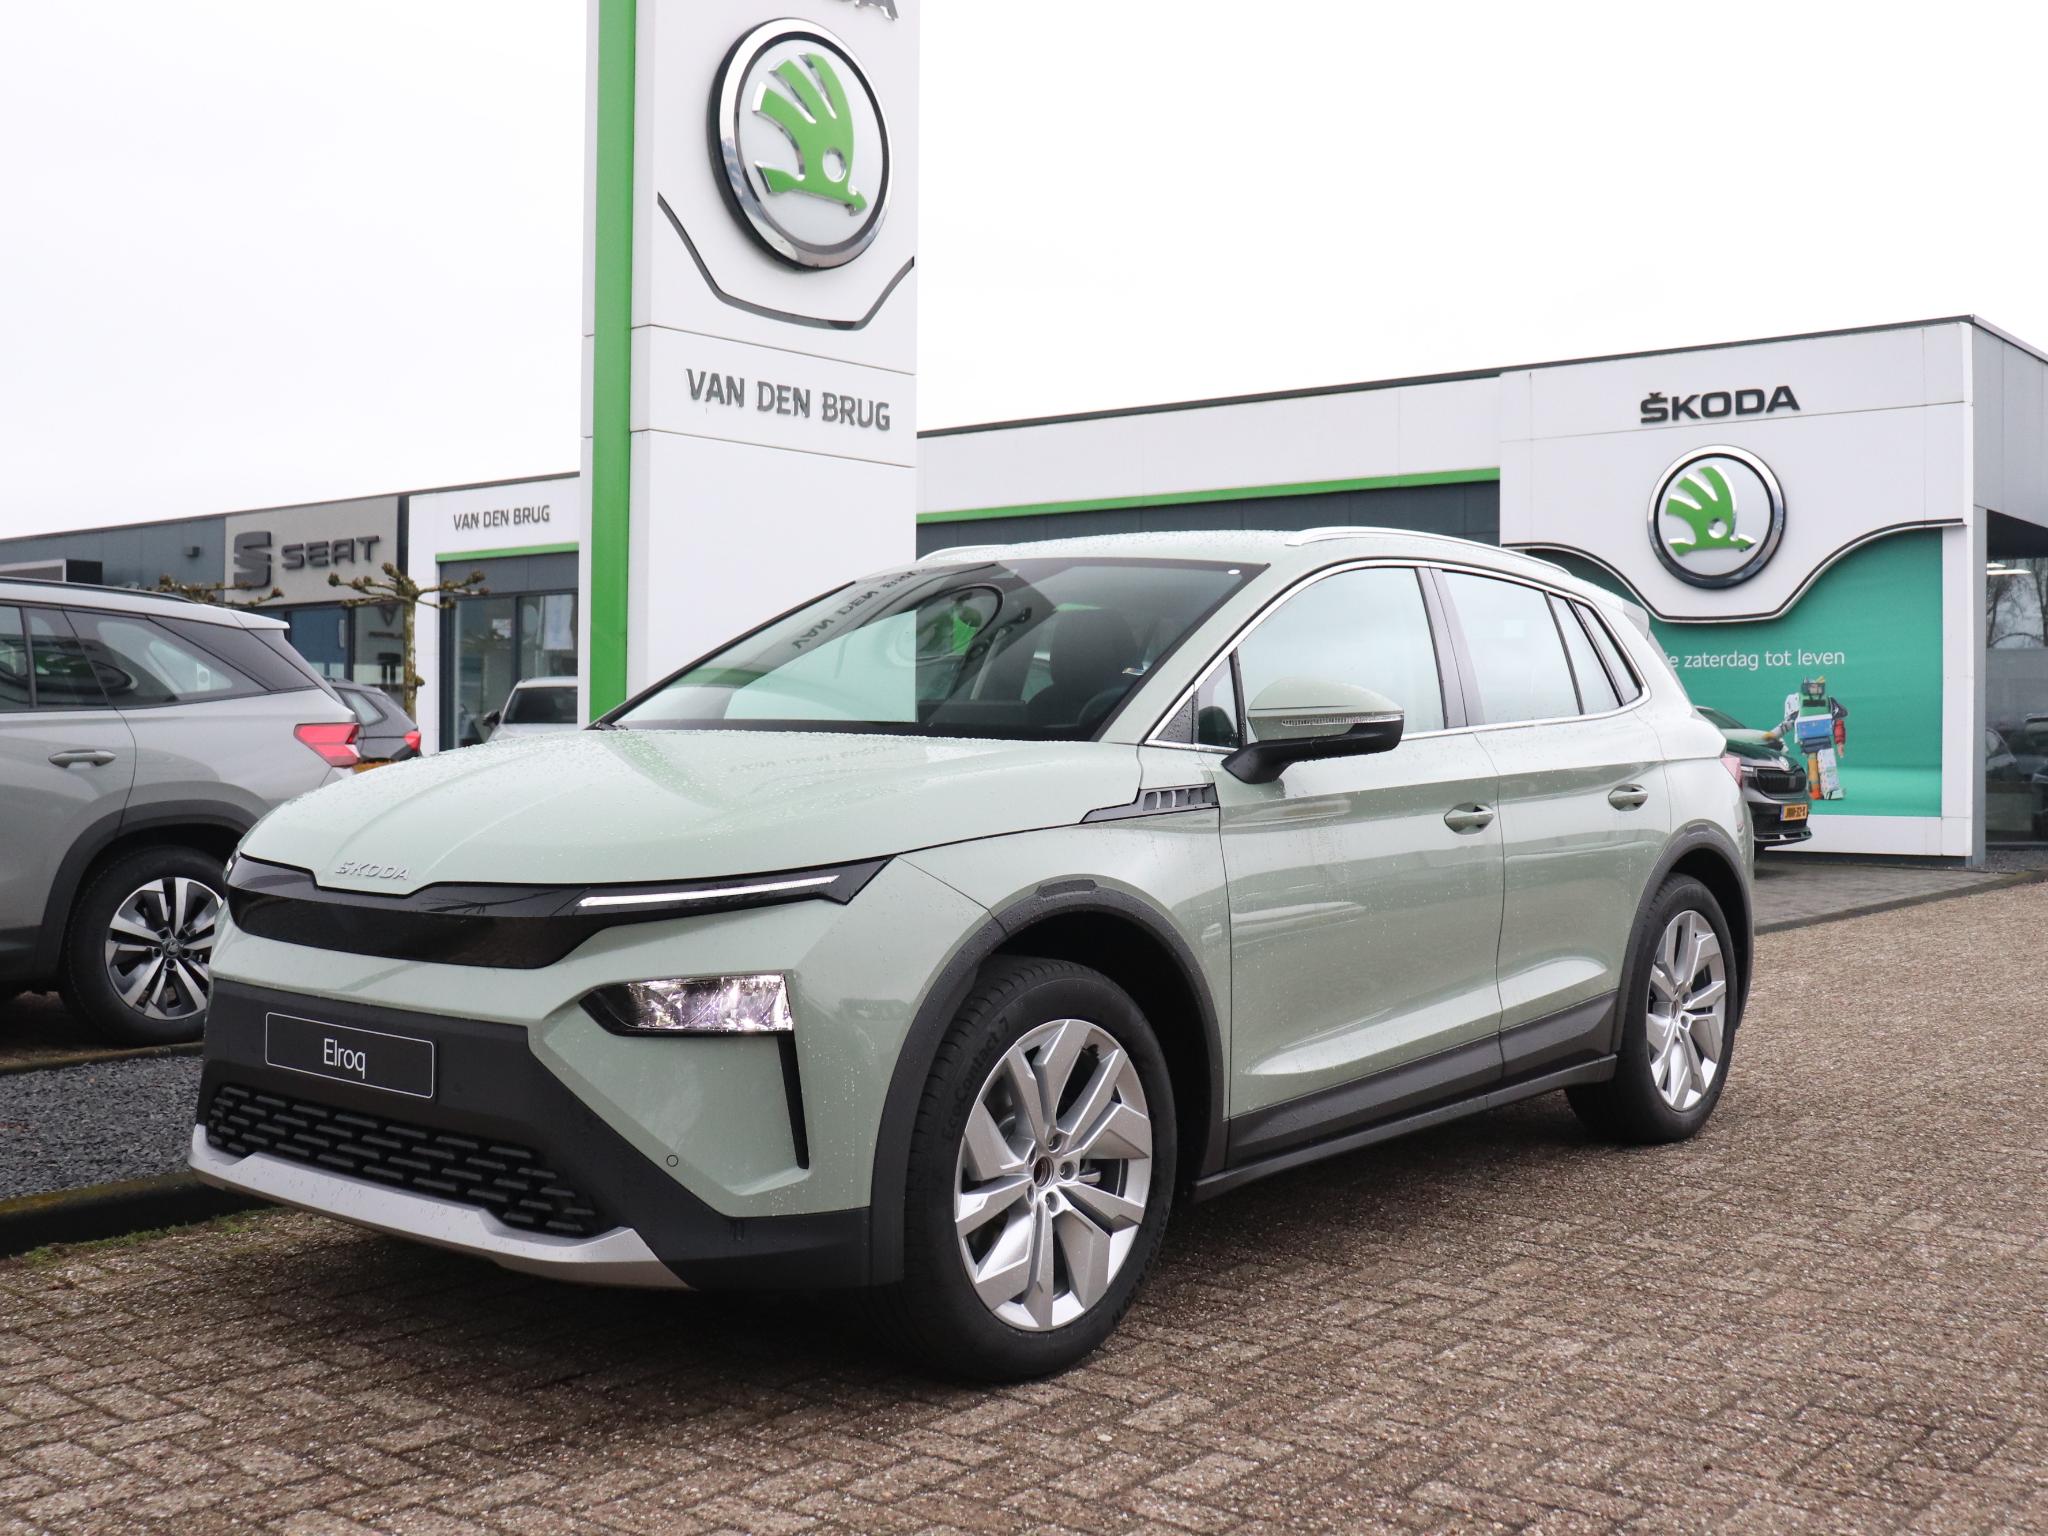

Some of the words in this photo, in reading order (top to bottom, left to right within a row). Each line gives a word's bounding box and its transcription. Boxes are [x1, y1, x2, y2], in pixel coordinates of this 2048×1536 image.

[686, 368, 745, 408] VAN
[757, 380, 810, 418] DEN
[822, 391, 890, 431] BRUG
[1640, 385, 1801, 424] ŠKODA
[453, 512, 480, 531] VAN
[483, 508, 509, 528] DEN
[513, 504, 550, 525] BRUG
[281, 535, 380, 570] SEAT
[1683, 648, 1759, 671] zaterdag
[1764, 650, 1792, 666] tot
[1797, 648, 1845, 666] leven
[323, 1037, 366, 1080] Elroq
